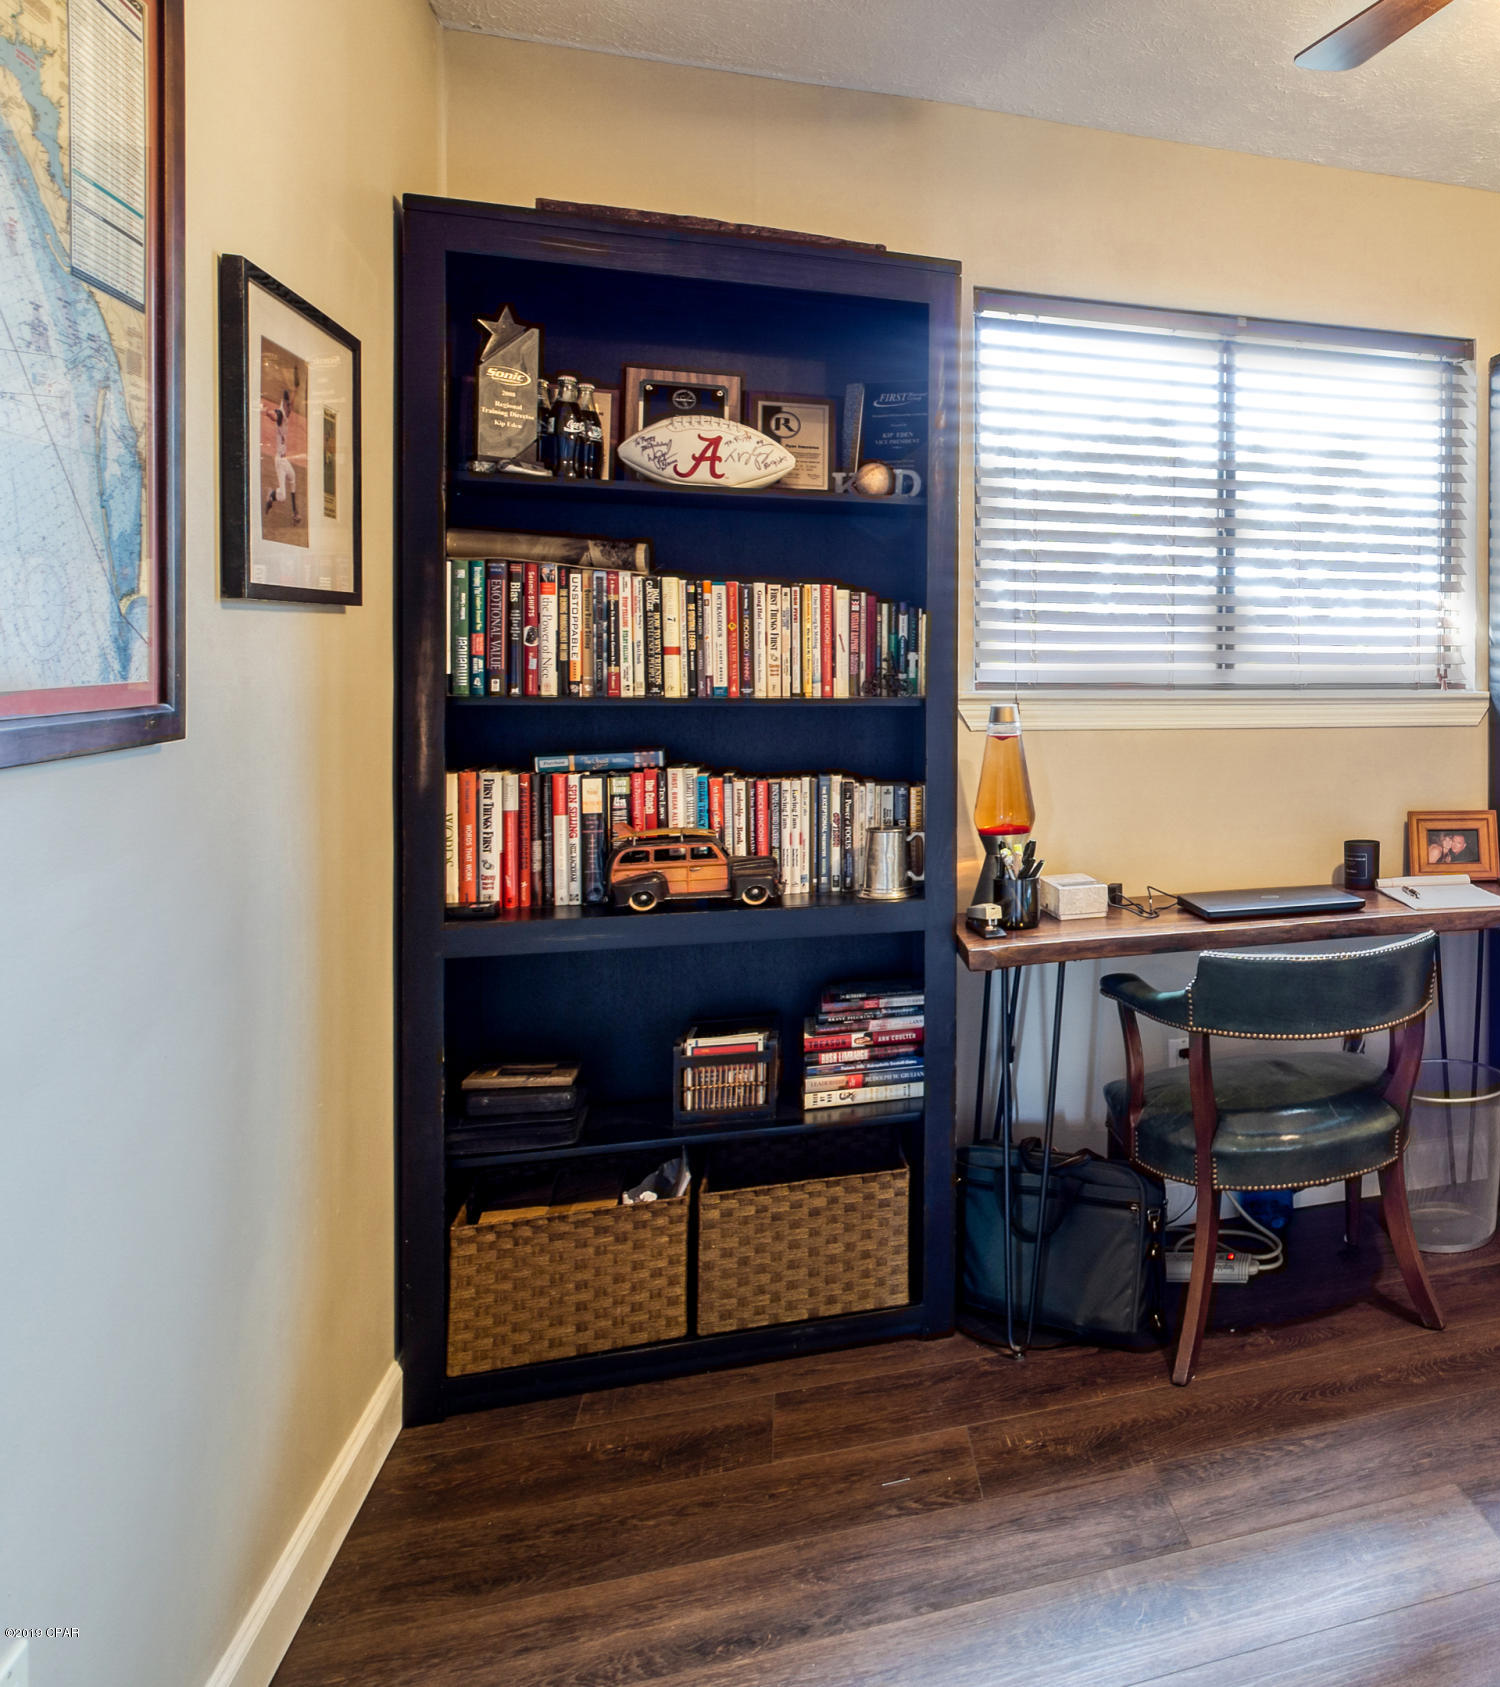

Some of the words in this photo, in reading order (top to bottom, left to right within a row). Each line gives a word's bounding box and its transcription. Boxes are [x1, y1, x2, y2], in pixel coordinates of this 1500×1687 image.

[774, 416, 797, 433] R
[673, 433, 726, 480] A
[510, 581, 521, 602] Bias
[528, 571, 537, 594] Seismic
[528, 595, 537, 617] SHIFTS
[542, 597, 553, 611] the
[755, 590, 763, 607] Gung
[770, 588, 779, 606] FIRST
[491, 579, 502, 638] EMOTIONAL
[571, 576, 579, 659] UNSTOPPABLE
[770, 608, 779, 631] THINGS
[542, 614, 553, 642] Power
[542, 643, 553, 655] of
[770, 632, 779, 651] FIRST
[490, 640, 502, 670] VALUE
[542, 657, 553, 678] Nice
[483, 778, 495, 800] FIRST
[568, 784, 577, 803] SPIN
[698, 781, 706, 804] BRIAN
[645, 792, 655, 815] Coach
[735, 788, 743, 818] Leadership
[844, 799, 852, 819] Power
[482, 802, 494, 829] THINGS
[568, 806, 578, 838] SELLING
[791, 814, 799, 830] Fans
[465, 824, 473, 846] WORDS
[482, 831, 494, 854] FIRST
[844, 826, 852, 850] FOCUS
[465, 847, 473, 862] THAT
[465, 863, 473, 882] WORK
[808, 1038, 847, 1049] TREASON
[891, 1032, 917, 1041] COULTER
[821, 1052, 838, 1065] RUSH
